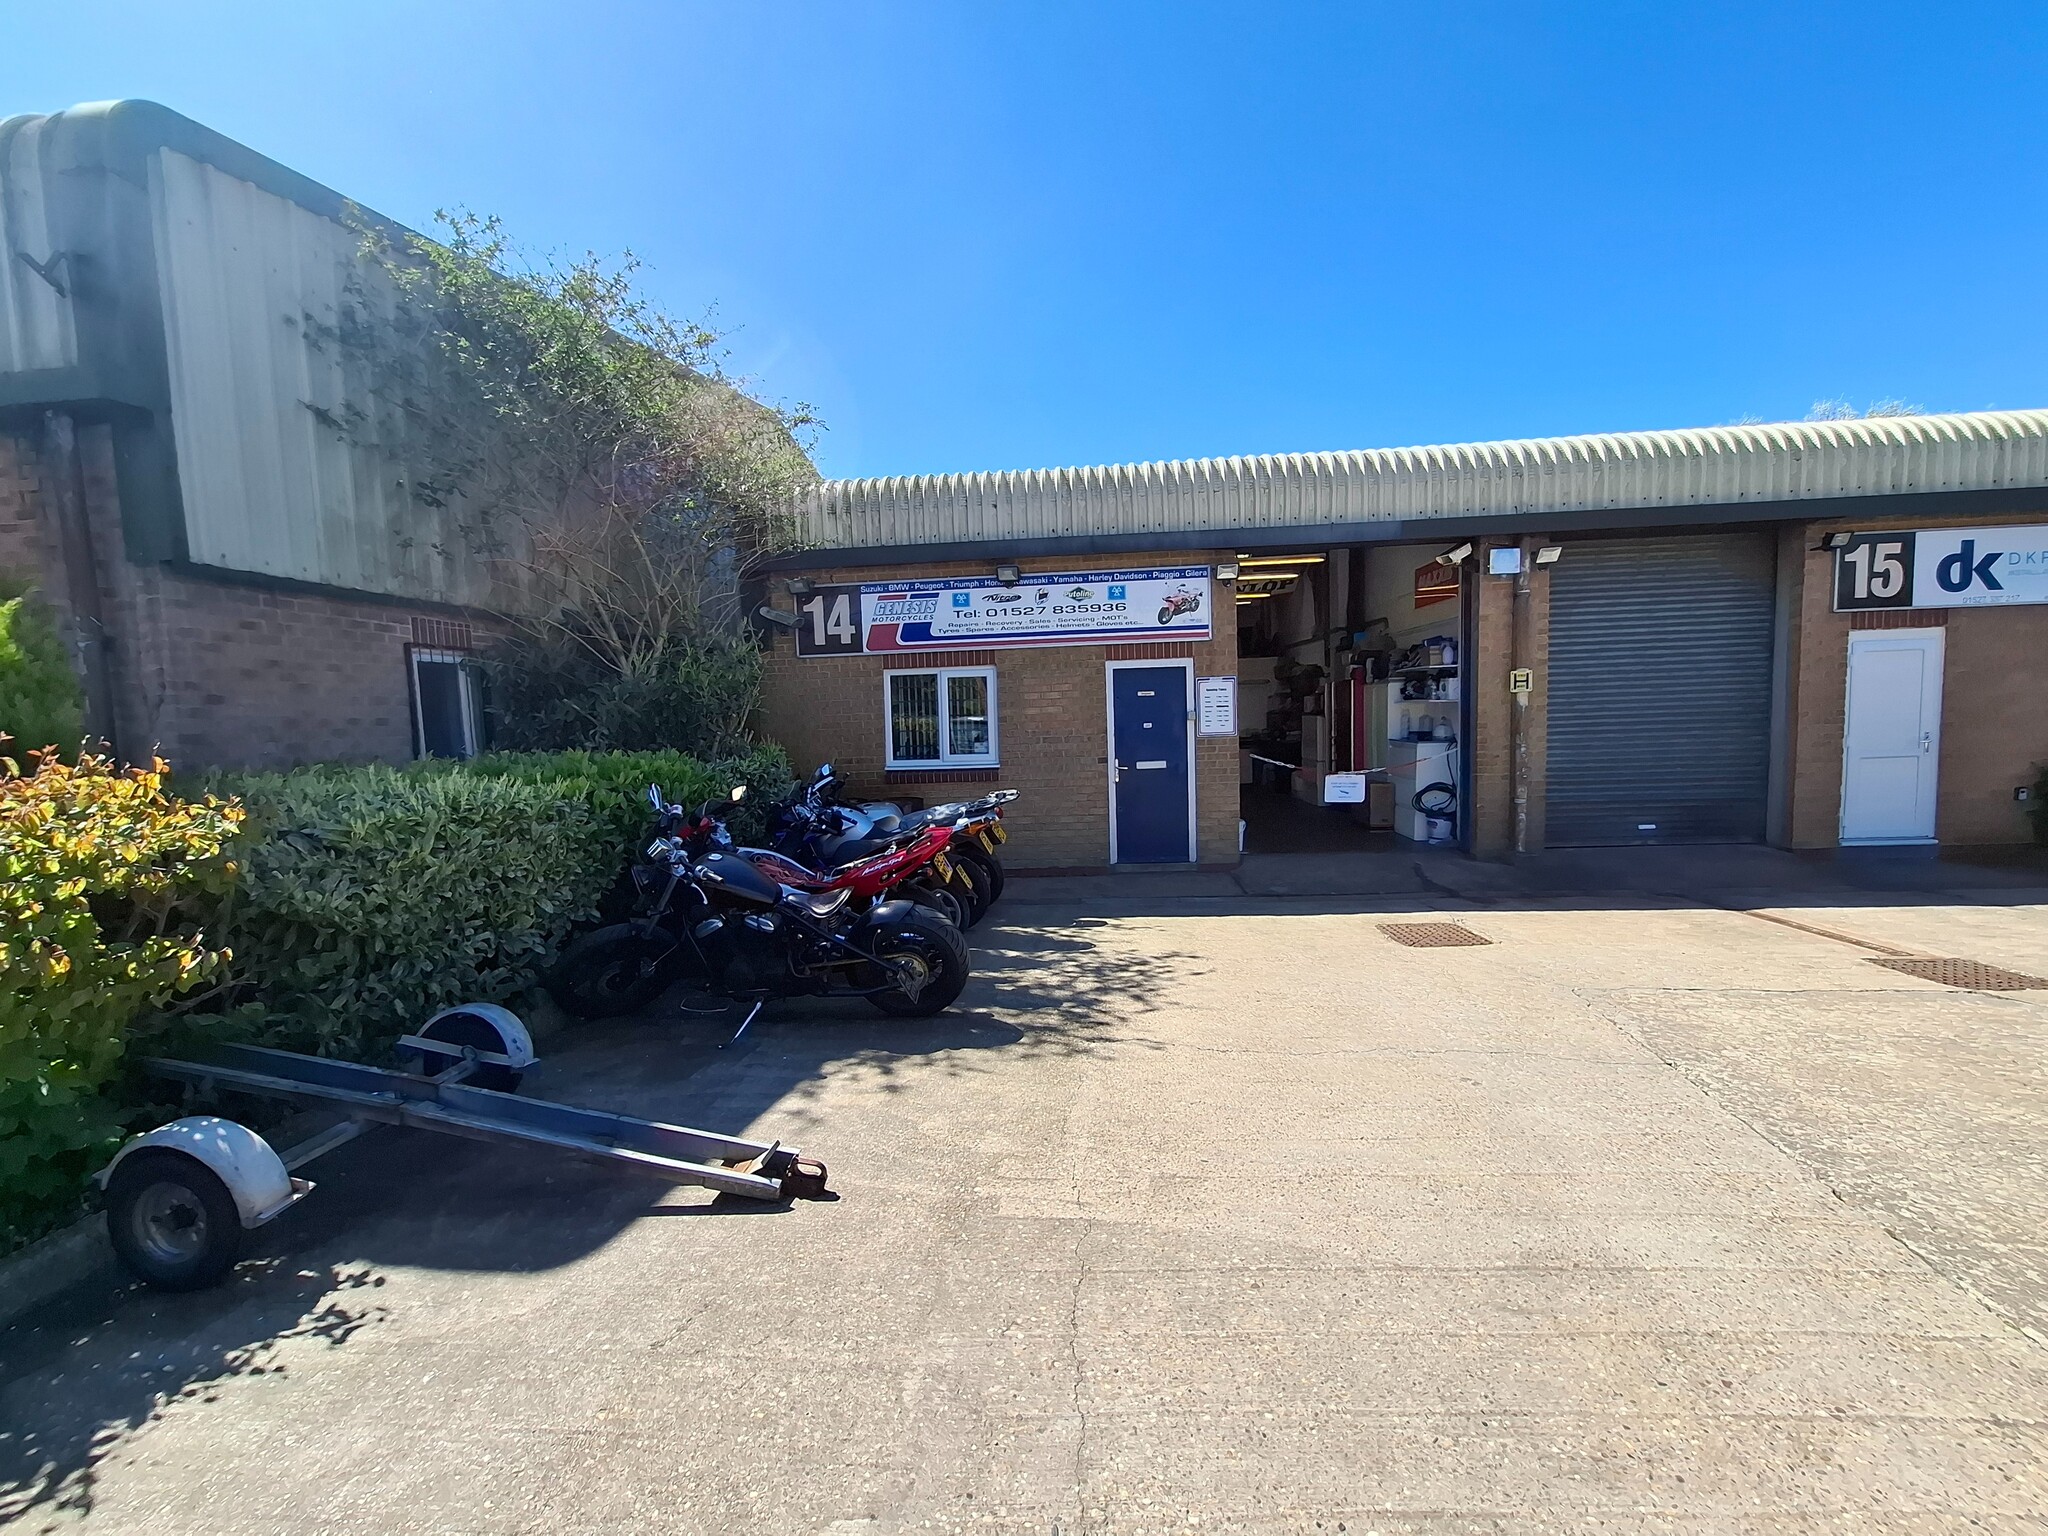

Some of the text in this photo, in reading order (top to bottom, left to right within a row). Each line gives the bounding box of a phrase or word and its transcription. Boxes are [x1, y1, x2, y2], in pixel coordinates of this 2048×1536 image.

[1844, 543, 1903, 599] 15
[1936, 539, 2004, 593] dk
[861, 584, 884, 593] Suzuki
[888, 583, 910, 592] BMW
[914, 582, 945, 591] Peugeot
[949, 580, 980, 589] Triumph
[984, 579, 1006, 587] Hon
[1053, 575, 1083, 584] Yamaha
[1088, 574, 1112, 582] Harley
[1113, 571, 1148, 580] Davidson
[1152, 570, 1180, 580] Piaggio
[1185, 569, 1208, 577] Gilera
[874, 600, 938, 616] GENESIS
[953, 602, 1127, 619] Tel: 01527 835936
[803, 594, 856, 646] 14
[871, 614, 935, 623] MOTORCYCLES
[1058, 615, 1095, 623] Servicing
